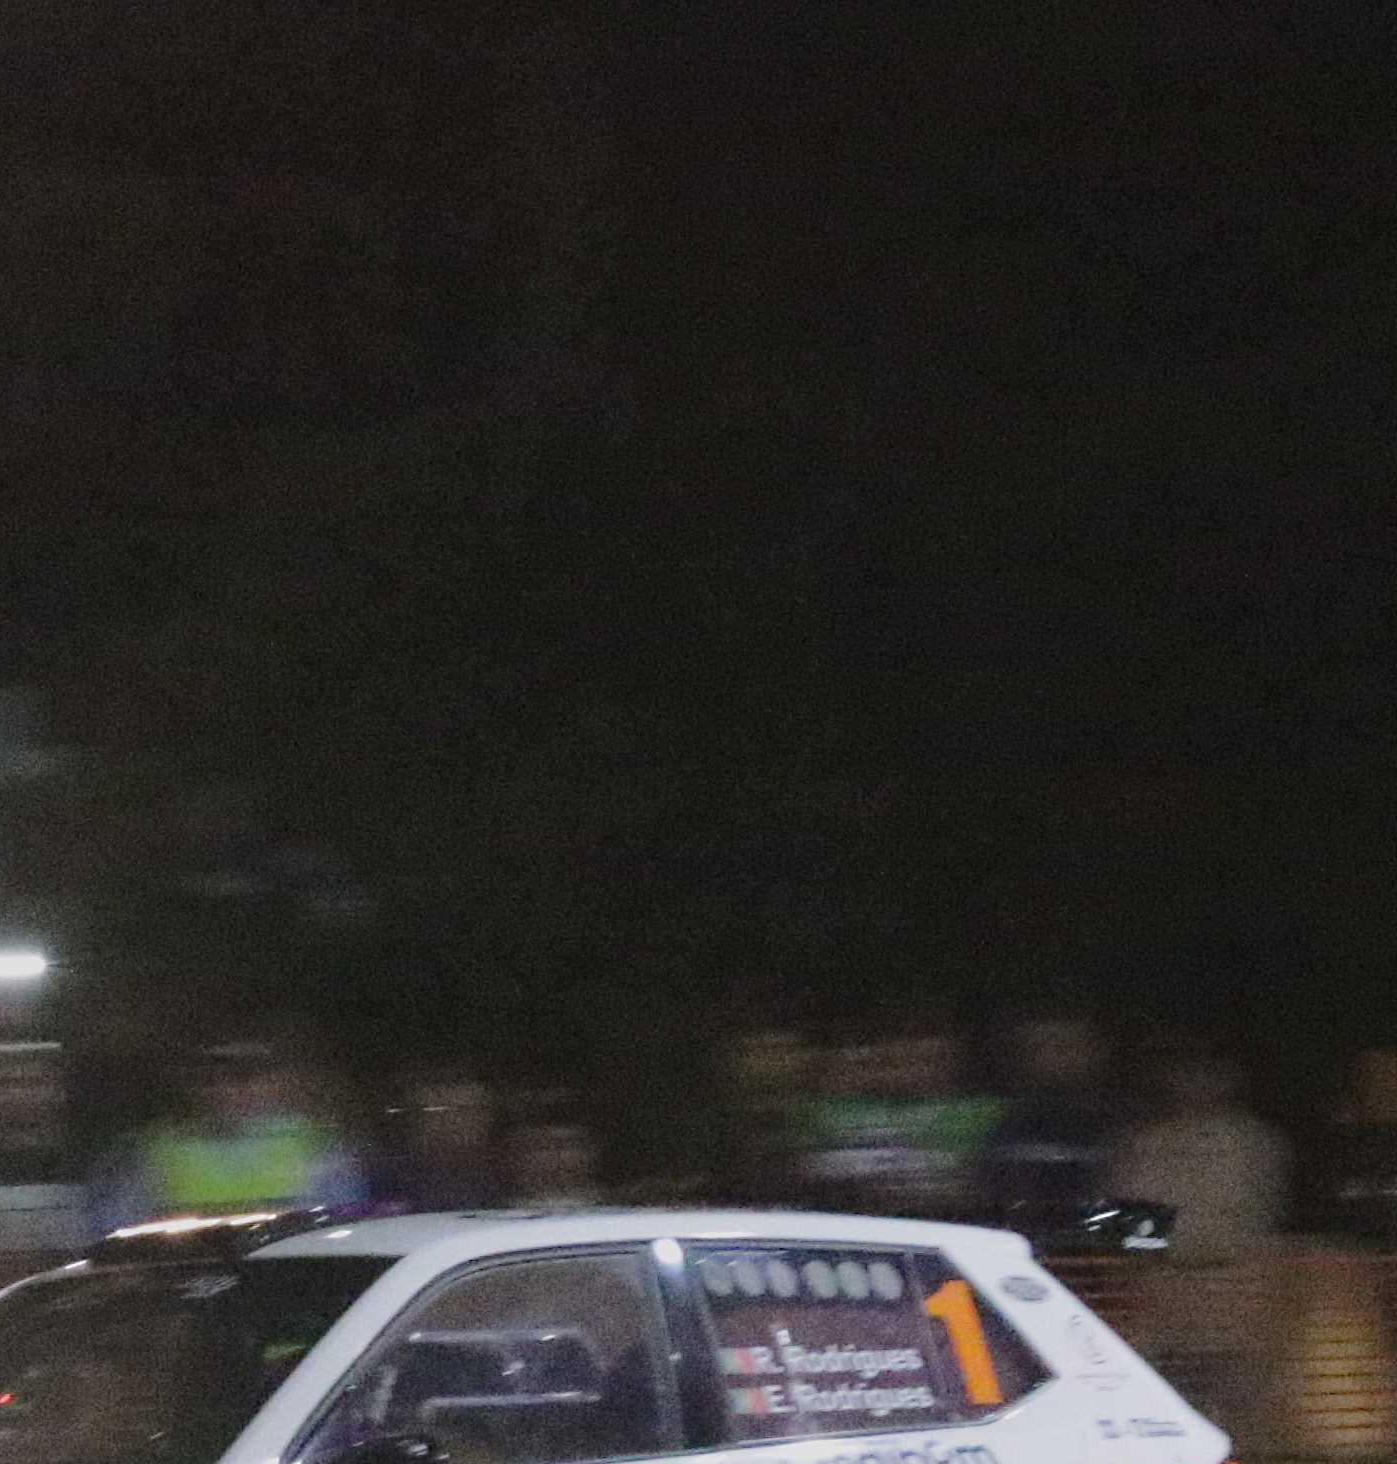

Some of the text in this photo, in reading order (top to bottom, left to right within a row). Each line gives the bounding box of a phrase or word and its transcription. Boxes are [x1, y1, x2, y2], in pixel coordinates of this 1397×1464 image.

[925, 1280, 1003, 1404] 1
[782, 1343, 924, 1379] Rodrigues
[792, 1382, 935, 1417] Rodrigues
